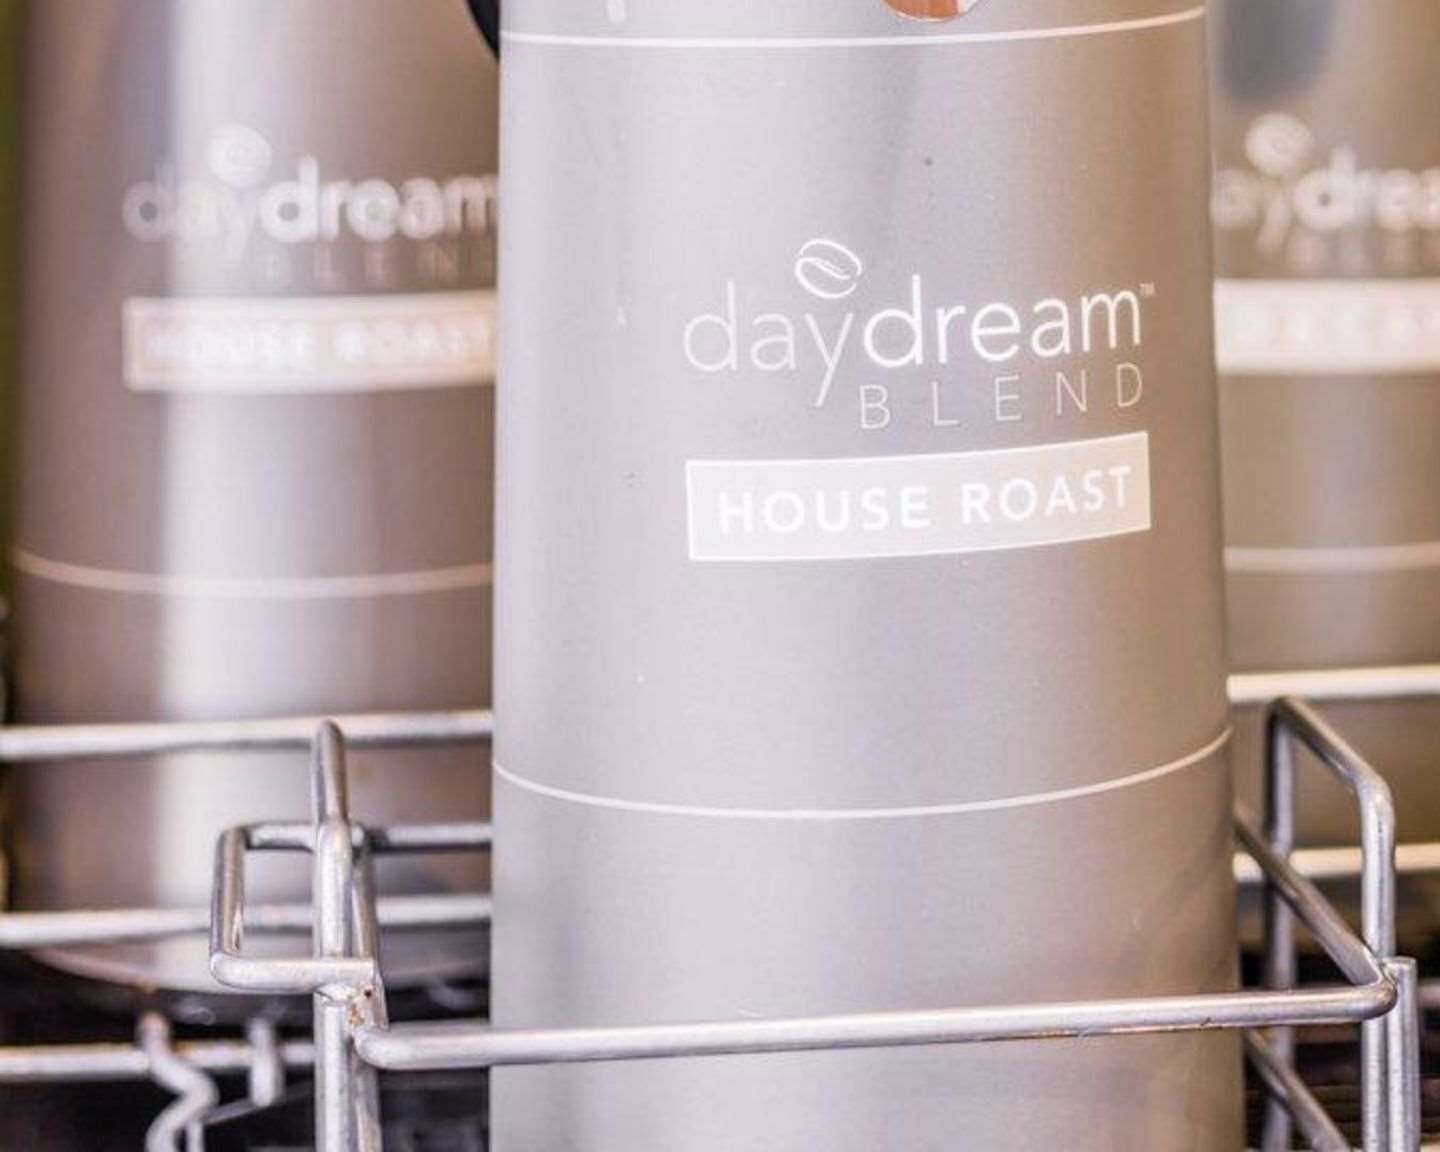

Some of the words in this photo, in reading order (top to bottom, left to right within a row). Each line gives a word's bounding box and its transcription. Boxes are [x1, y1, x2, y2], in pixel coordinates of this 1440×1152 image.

[683, 273, 1141, 407] daydream
[859, 362, 1143, 430] BLEND
[719, 486, 932, 536] HOUSE
[960, 465, 1132, 524] ROAST
